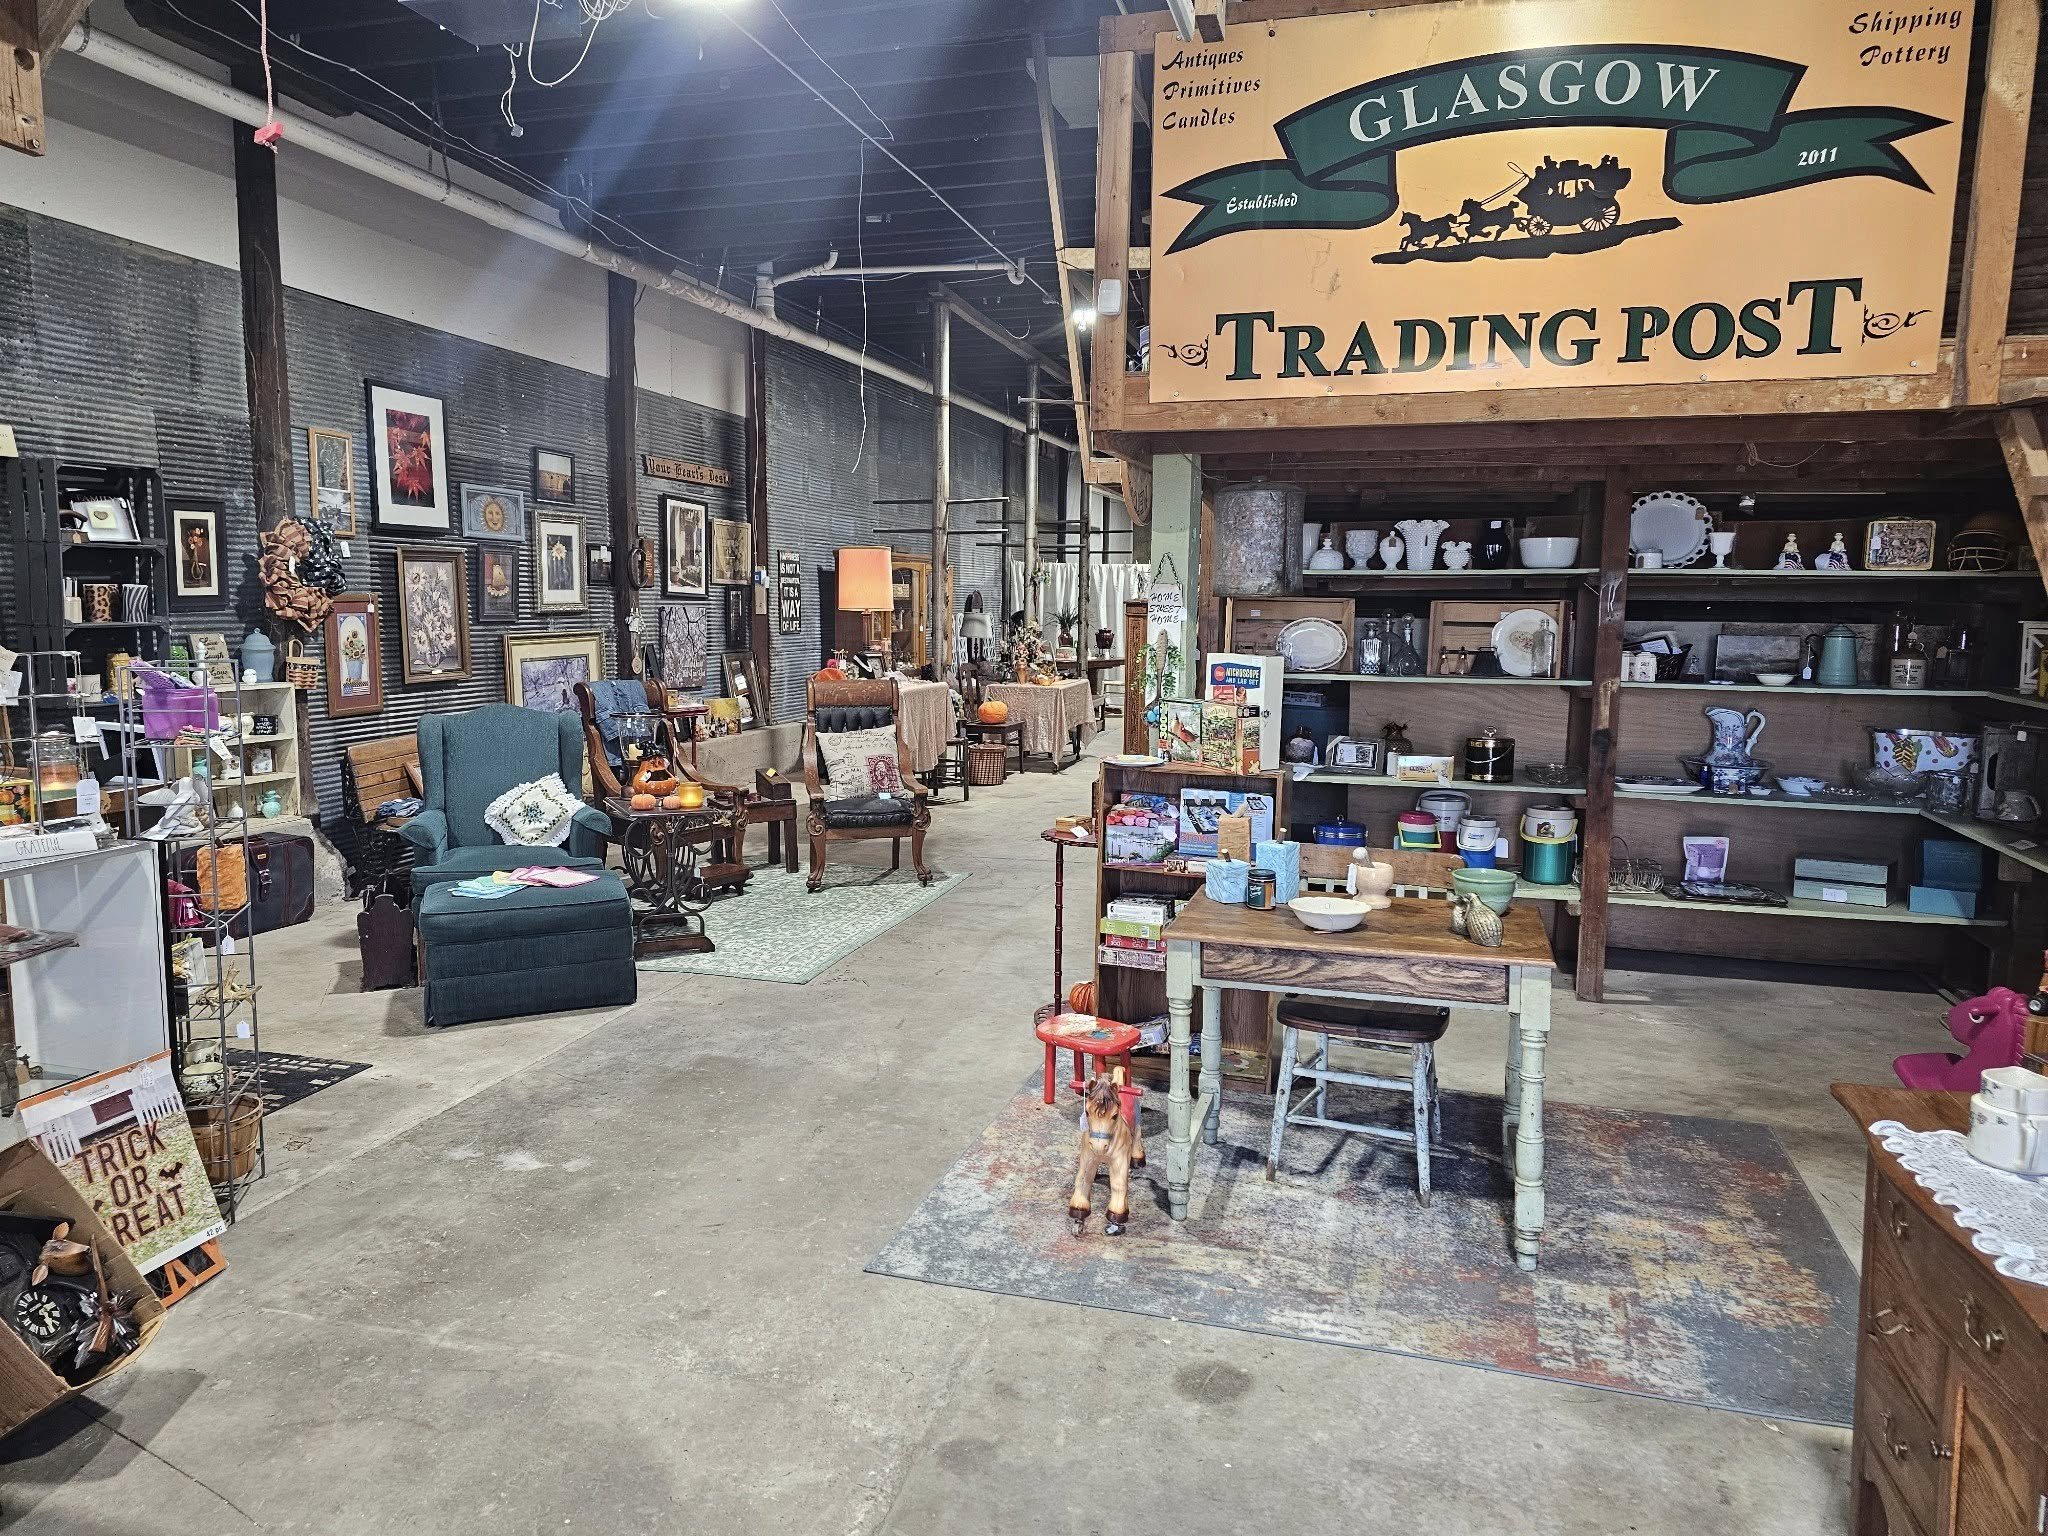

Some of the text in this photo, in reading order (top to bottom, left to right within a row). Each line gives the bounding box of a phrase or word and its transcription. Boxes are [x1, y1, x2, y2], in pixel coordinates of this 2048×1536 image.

[1848, 6, 1962, 36] Shipping
[1161, 49, 1244, 71] Antiques
[1859, 45, 1951, 67] Pottery
[1162, 76, 1261, 101] Primitives
[1348, 59, 1721, 143] GLASGOW
[1162, 107, 1235, 130] Candles
[1797, 146, 1838, 167] 2011
[1226, 192, 1298, 214] Established
[1215, 277, 1864, 381] TRADING POST
[648, 457, 671, 475] Your
[708, 469, 734, 486] Desi
[786, 563, 796, 574] NOT
[783, 586, 789, 598] IT
[1150, 592, 1180, 603] HOME
[781, 599, 801, 618] WAY
[1149, 604, 1182, 614] SWEET
[782, 620, 800, 632] OF LIFE
[1150, 614, 1180, 626] HOME
[1225, 667, 1260, 678] MICROSCOPE
[1237, 677, 1248, 685] LAB
[74, 1119, 166, 1185] TRICK
[110, 1165, 153, 1208] OR
[103, 1183, 186, 1247] REAT
